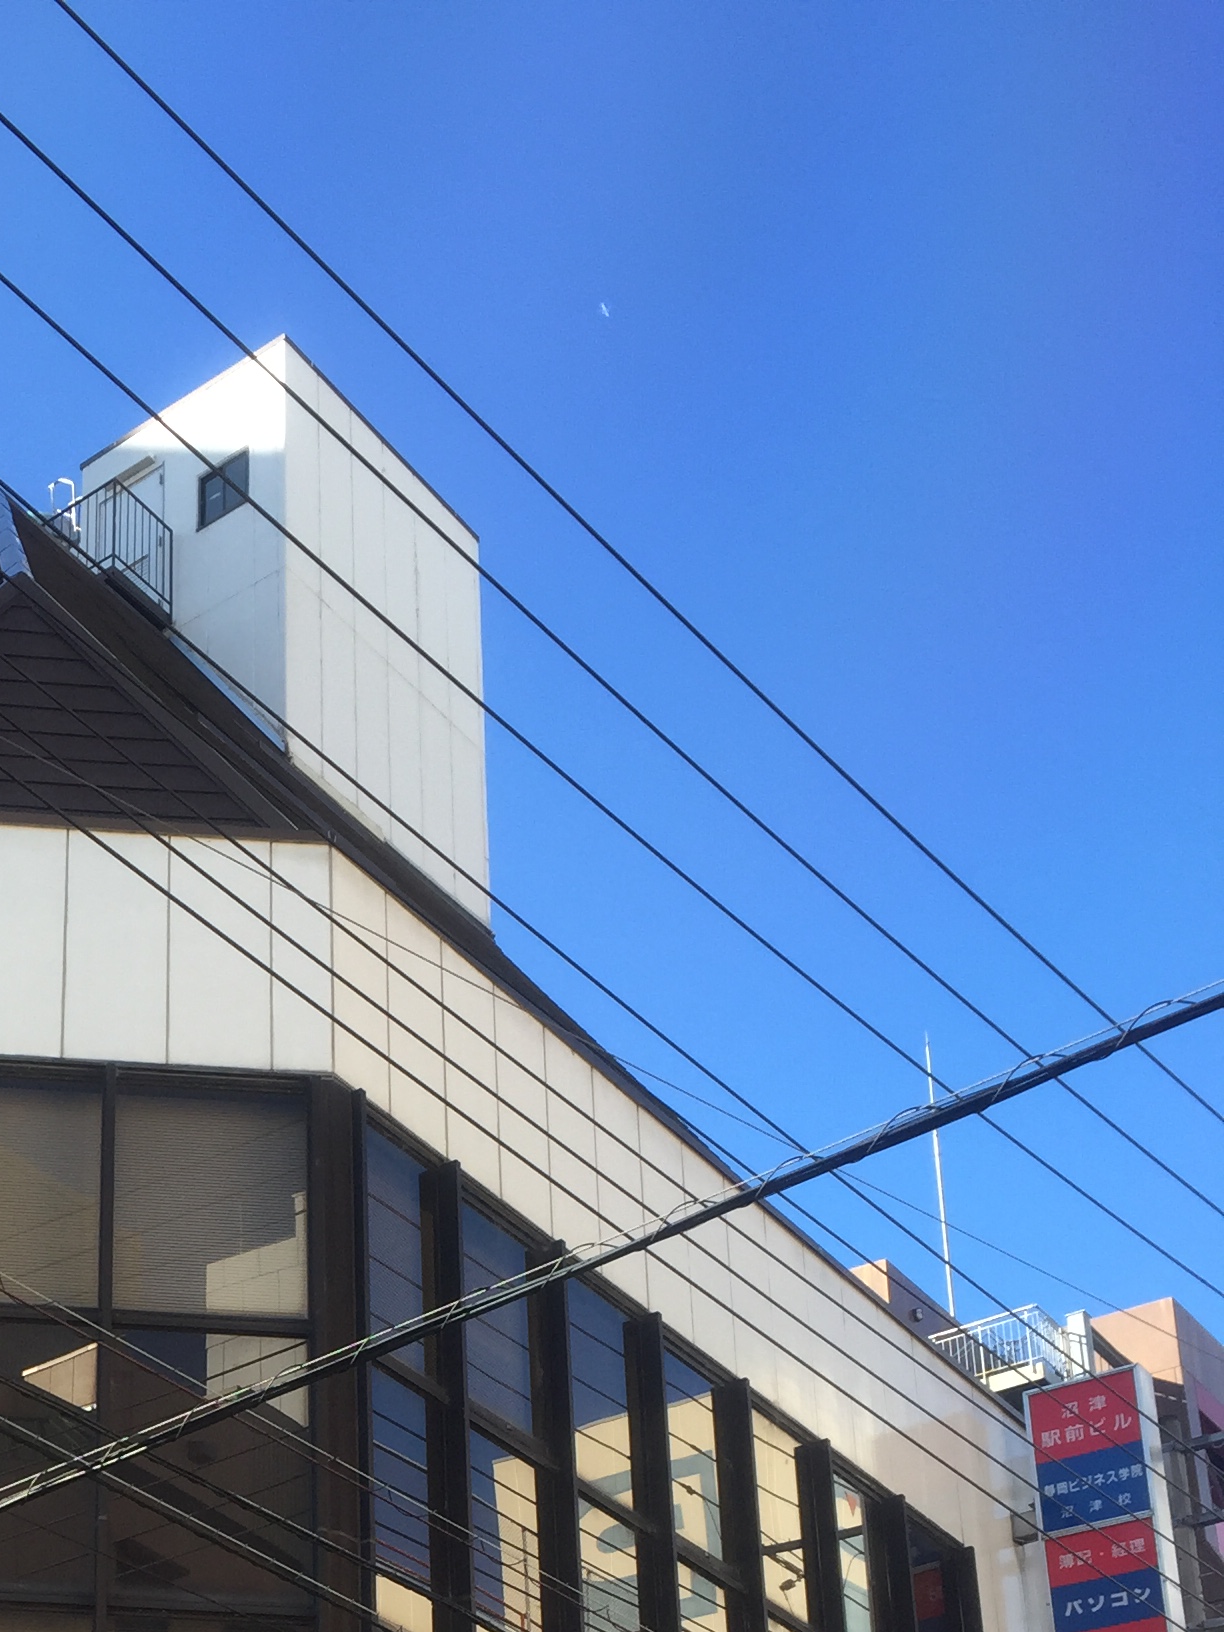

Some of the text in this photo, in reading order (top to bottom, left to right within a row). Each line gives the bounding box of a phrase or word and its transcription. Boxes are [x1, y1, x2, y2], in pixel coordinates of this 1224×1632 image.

[1061, 1395, 1107, 1419] 沼津
[1041, 1413, 1132, 1448] 駅前ビル
[1043, 1463, 1145, 1497] 静岡ビジネス学院
[1060, 1492, 1132, 1519] 沼津校
[1064, 1587, 1151, 1617] パソコン
